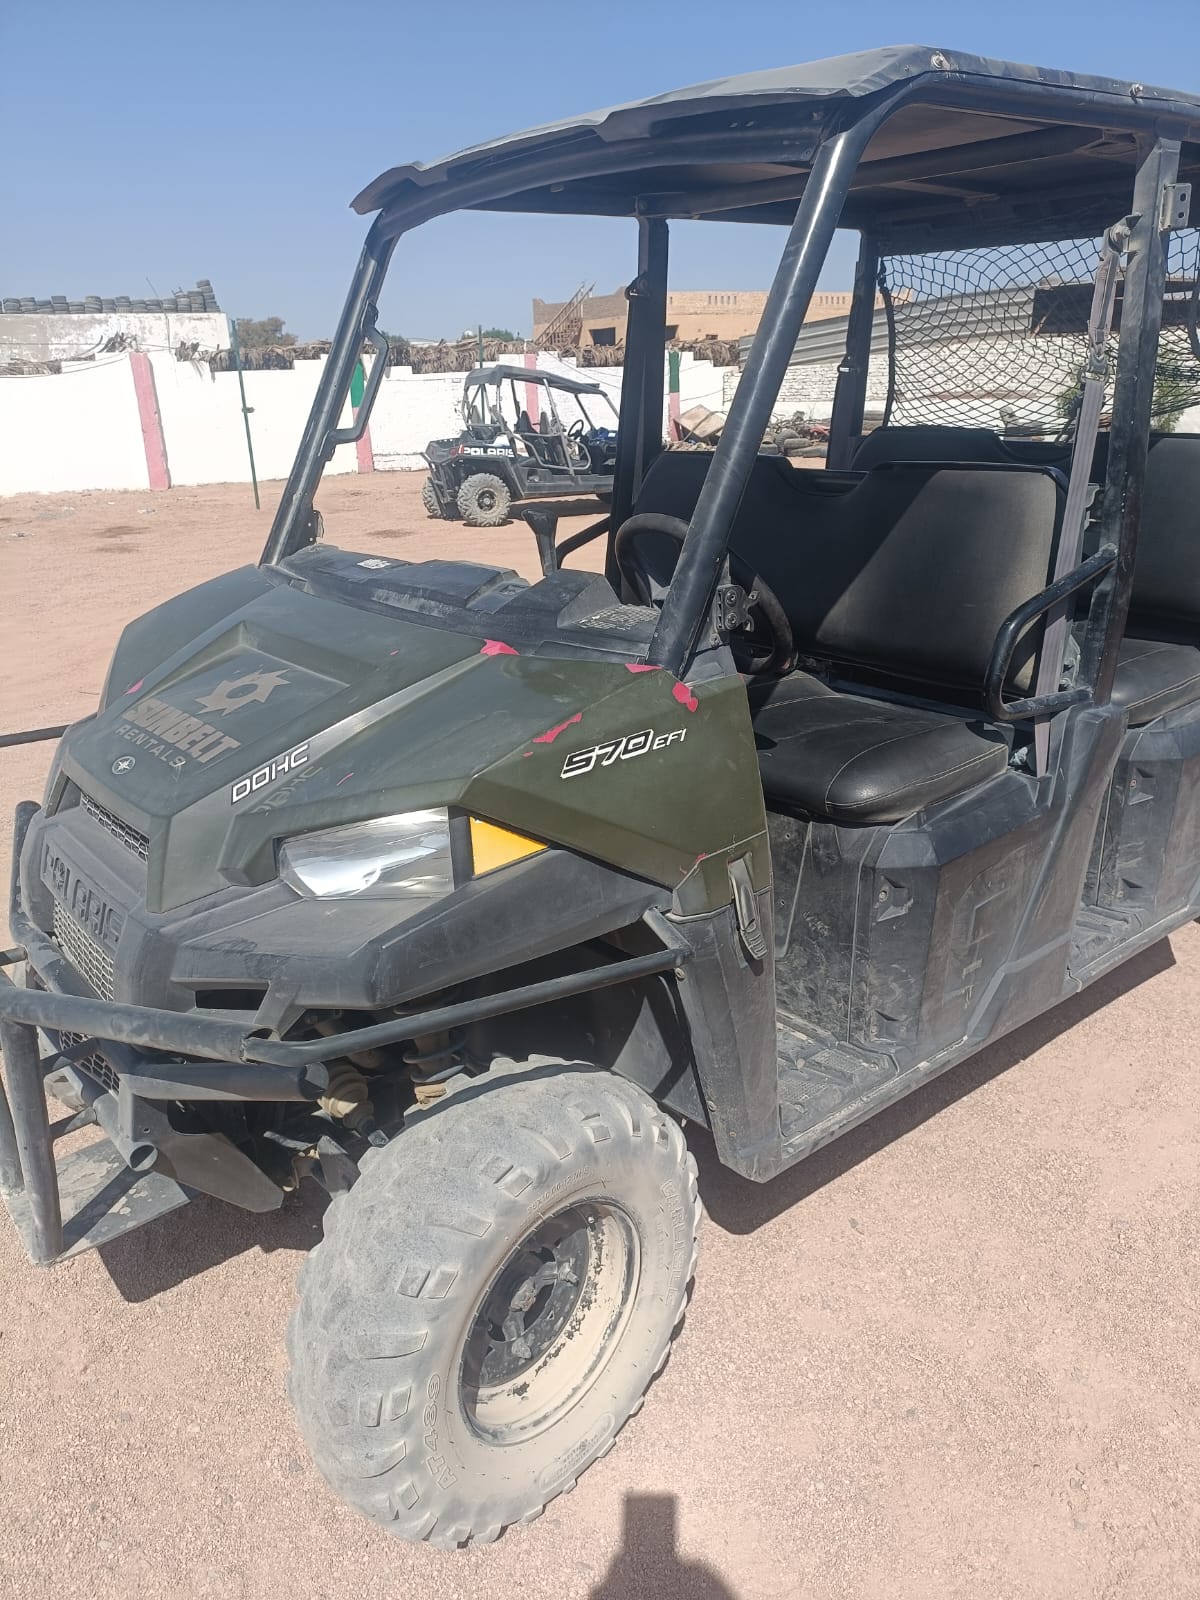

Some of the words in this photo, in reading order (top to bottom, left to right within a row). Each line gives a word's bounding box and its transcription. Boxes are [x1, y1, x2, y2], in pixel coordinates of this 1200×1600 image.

[462, 446, 515, 458] POLARIS
[115, 723, 187, 768] RENTALS
[122, 697, 241, 763] SUNBELT
[560, 728, 654, 779] 570
[652, 727, 687, 751] EFI
[231, 743, 309, 805] DOHC
[43, 843, 123, 948] POLARIS
